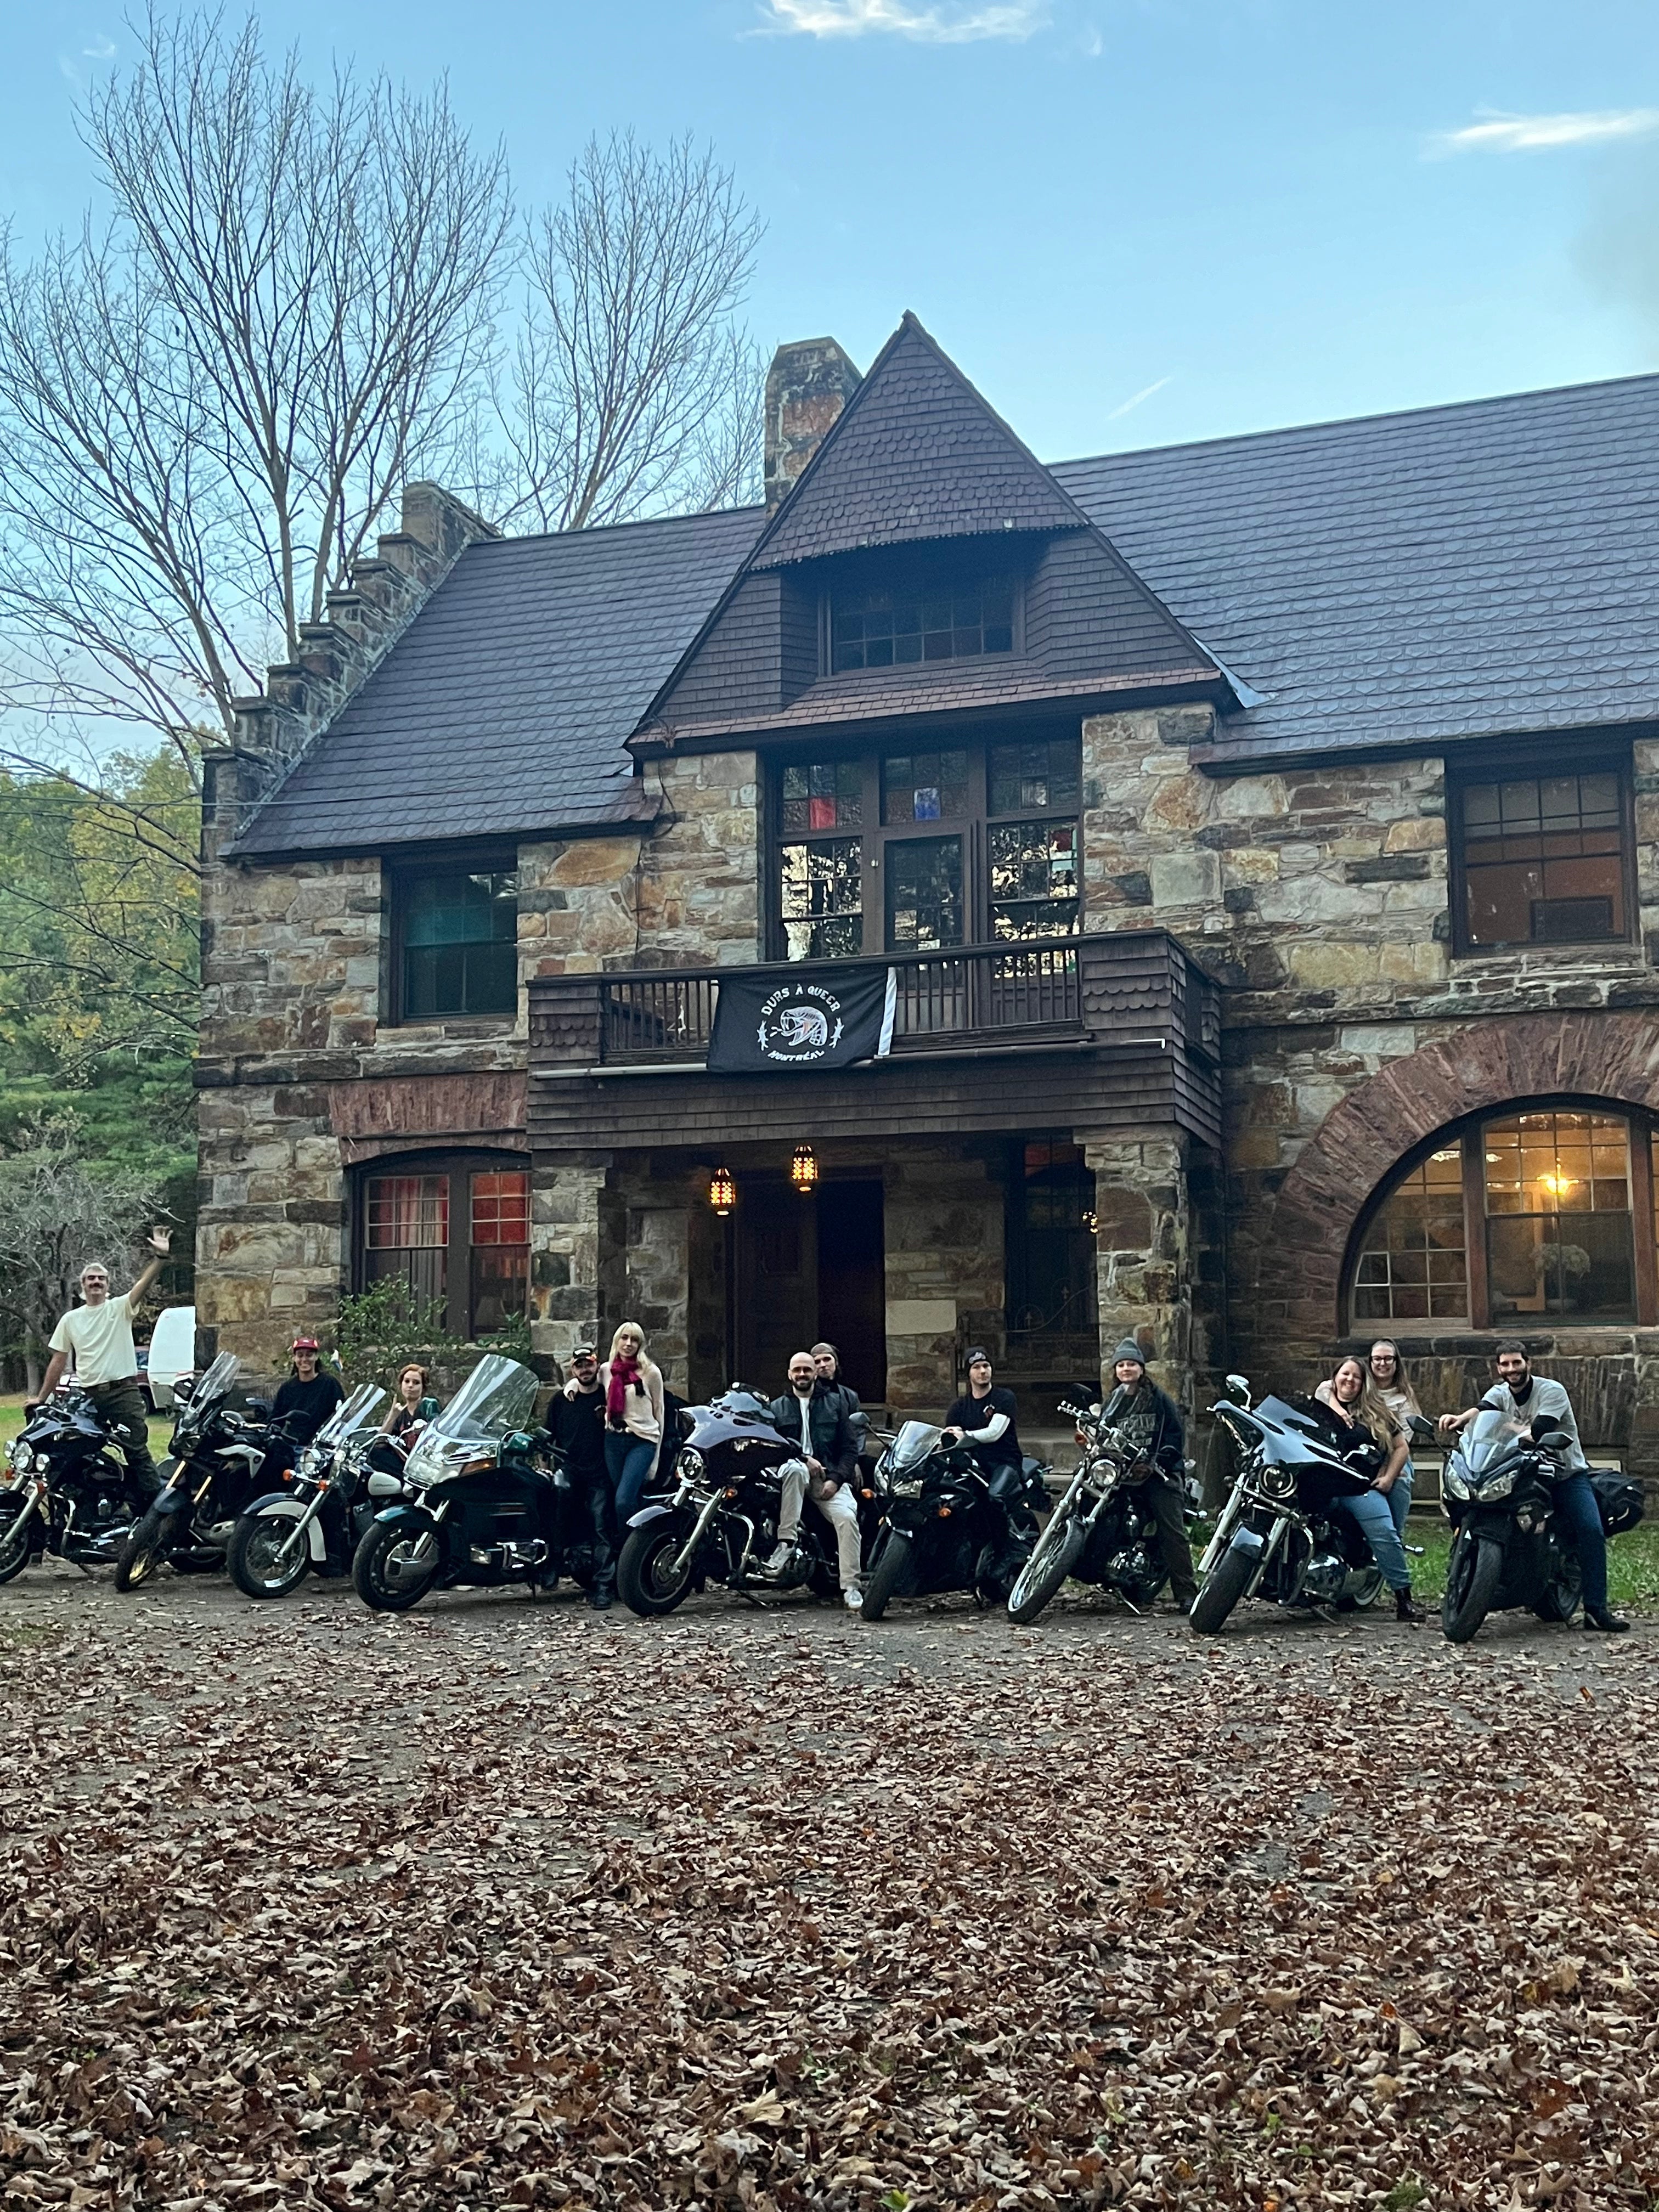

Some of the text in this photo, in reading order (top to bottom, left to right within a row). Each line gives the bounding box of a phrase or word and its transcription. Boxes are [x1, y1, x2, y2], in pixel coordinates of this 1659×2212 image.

[761, 984, 840, 1015] DURS À QUEER
[768, 1050, 825, 1062] MONTRÉAL
